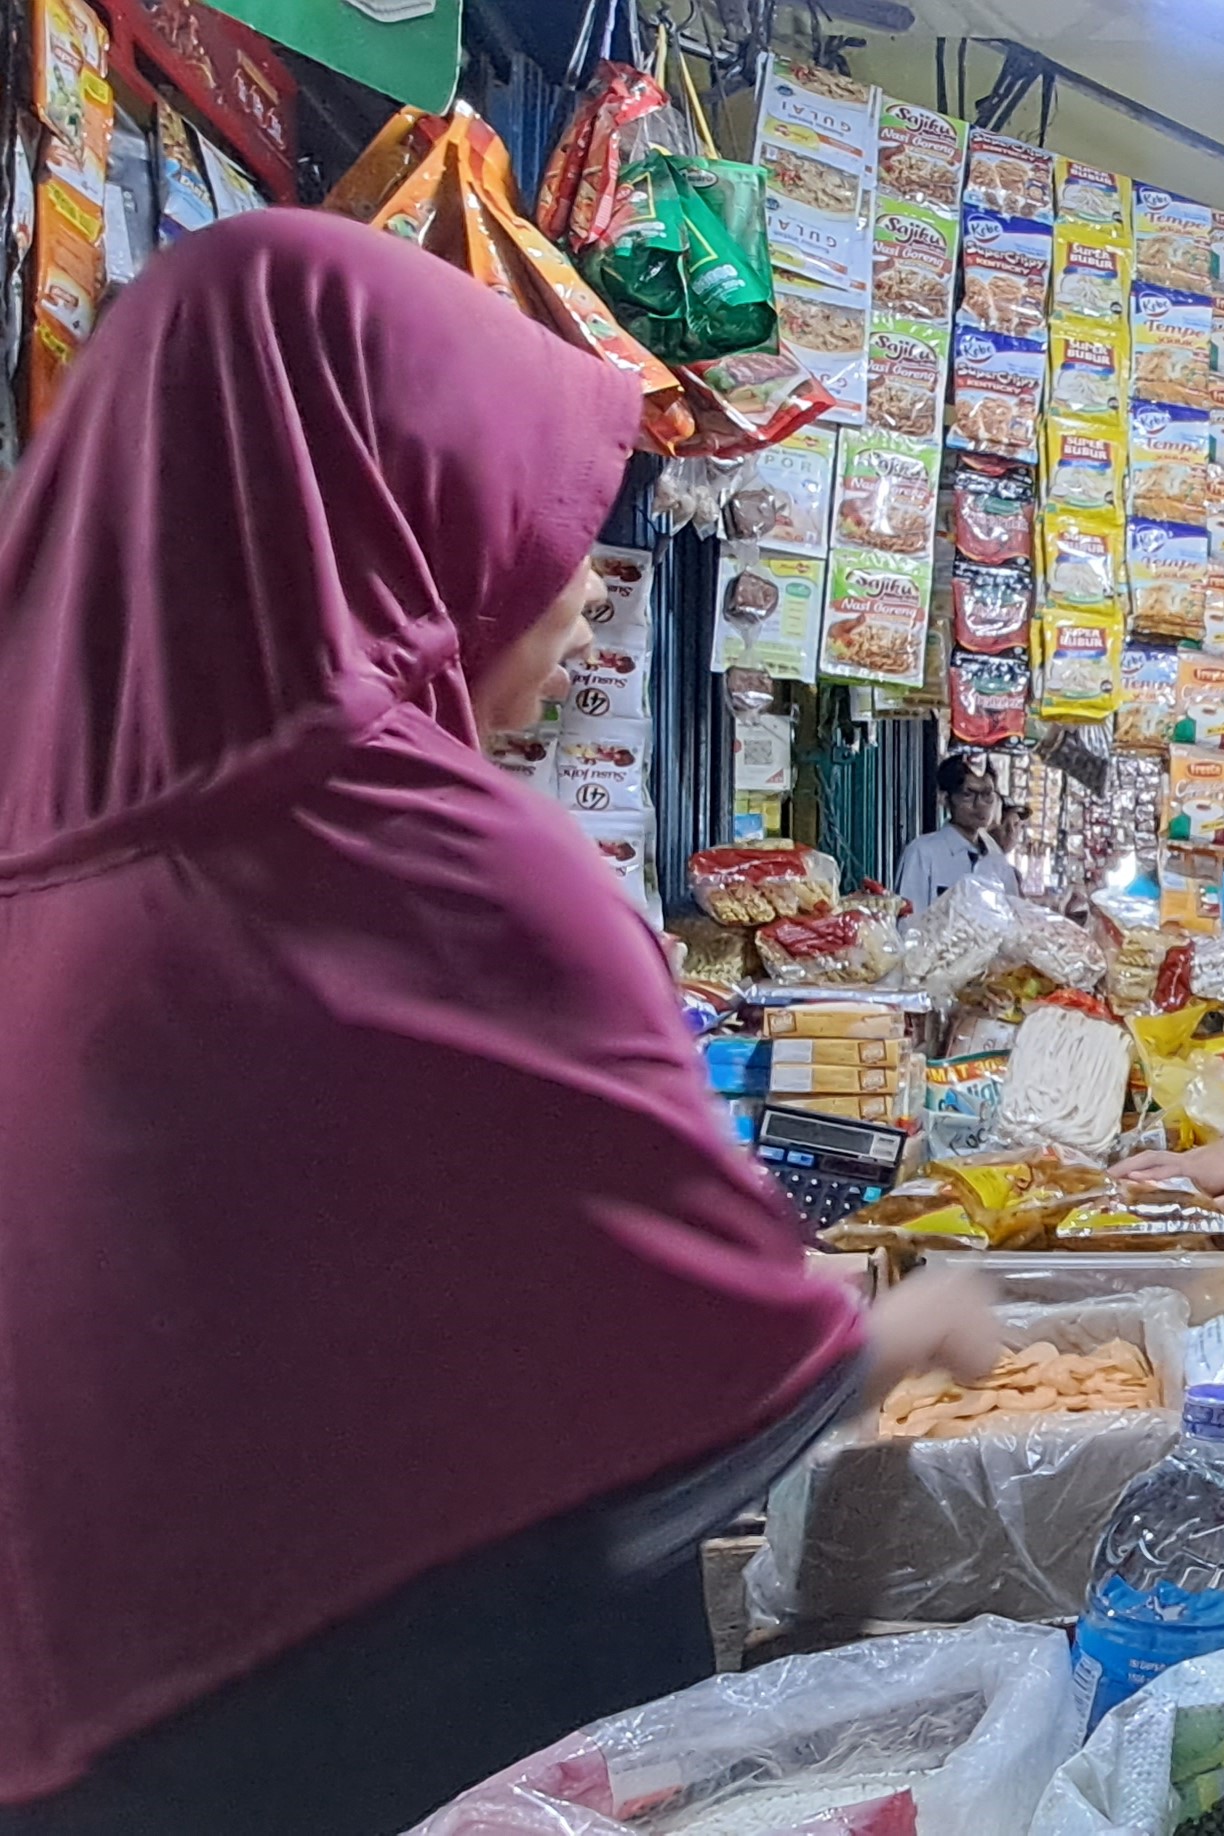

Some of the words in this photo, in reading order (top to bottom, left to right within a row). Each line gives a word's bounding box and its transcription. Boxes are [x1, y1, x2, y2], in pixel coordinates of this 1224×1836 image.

[781, 100, 852, 133] GULAI
[894, 106, 952, 135] Sajiku
[881, 128, 909, 144] Nasi
[912, 137, 955, 157] Goreng
[885, 216, 942, 245] Sajiku
[1144, 211, 1207, 231] Tempe
[768, 216, 838, 247] GULAI
[902, 249, 945, 268] Goreng
[975, 257, 1030, 275] KENTUCKY
[1070, 253, 1113, 271] BUBUR
[1144, 319, 1206, 338] Tempe
[1067, 349, 1111, 366] BUBUR
[892, 364, 936, 383] Goreng
[966, 378, 1022, 394] KENTUCKY
[1064, 445, 1108, 460] BUBUR
[1066, 436, 1105, 450] SUPER
[841, 599, 871, 611] Nasi
[873, 600, 918, 618] Goreng
[591, 673, 628, 688] Susu
[591, 771, 627, 782] Susu
